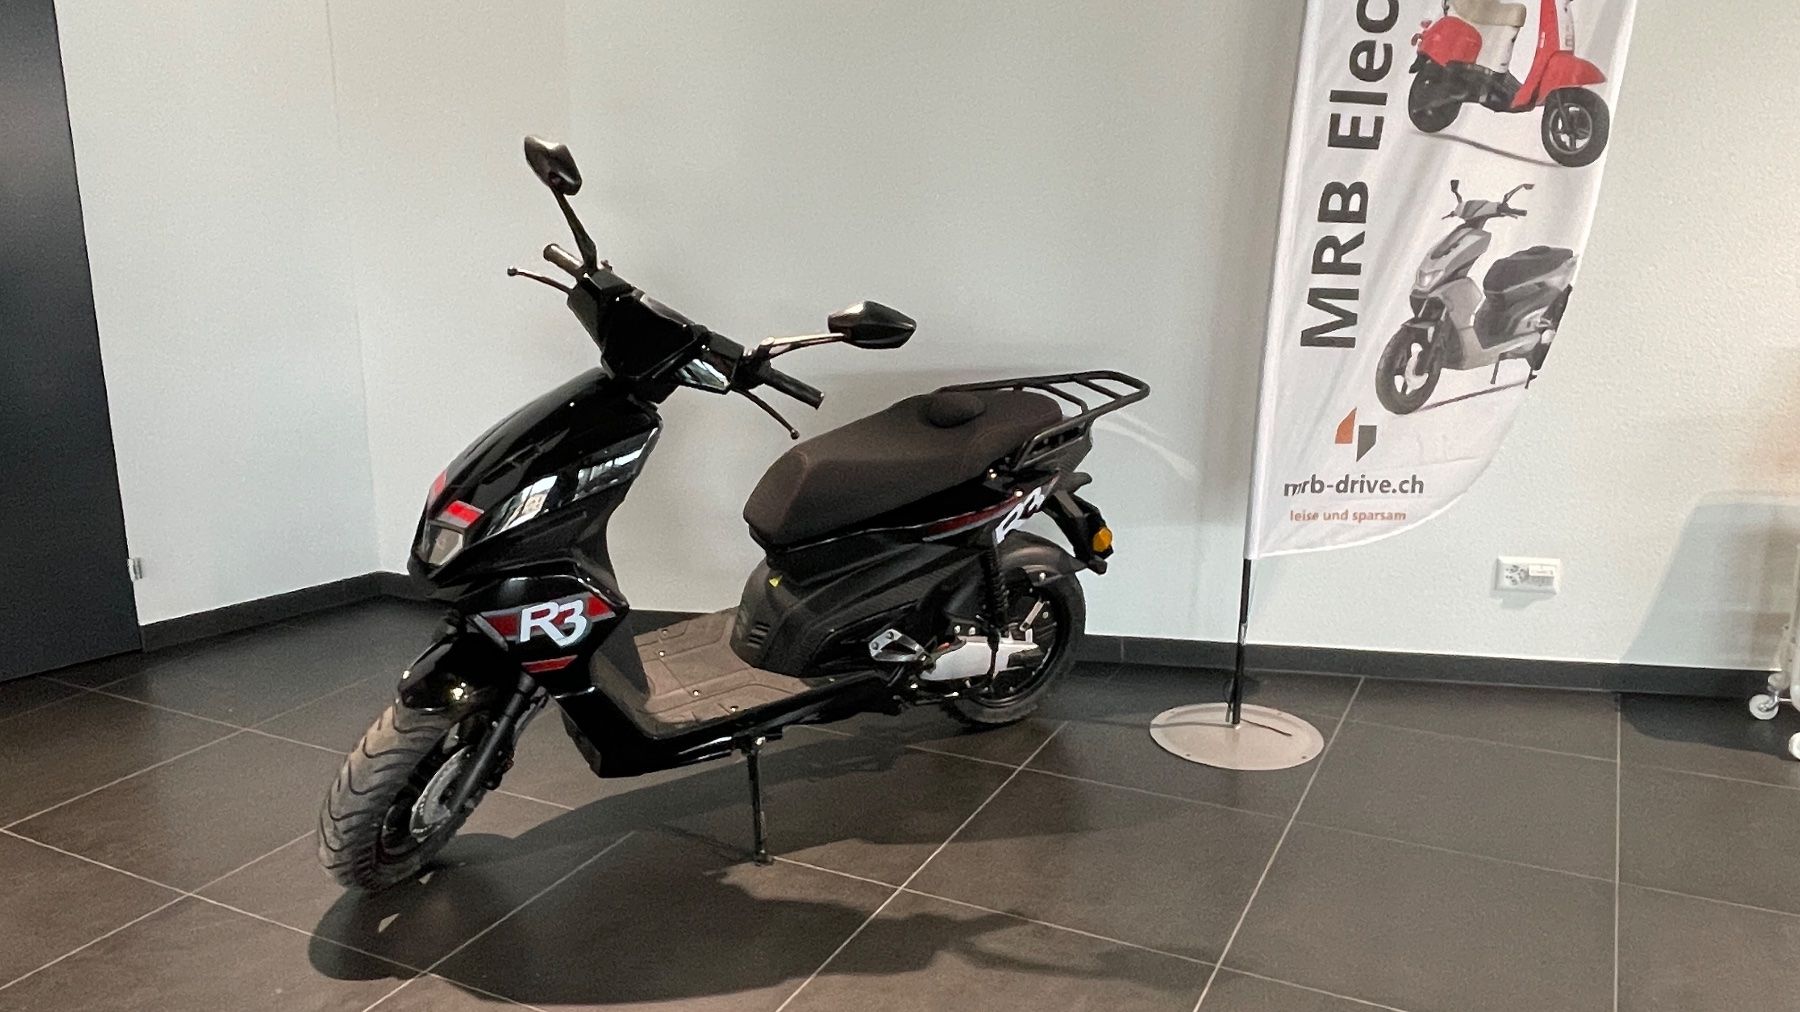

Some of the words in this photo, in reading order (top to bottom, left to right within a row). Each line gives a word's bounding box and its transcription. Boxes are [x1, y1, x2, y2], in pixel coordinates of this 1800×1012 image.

[1328, 0, 1400, 150] Elec
[1300, 181, 1369, 348] MRB
[1284, 474, 1424, 496] mrb-drive.ch
[1290, 510, 1319, 522] leise
[1323, 509, 1348, 521] und
[1352, 510, 1407, 524] sparsam
[519, 599, 588, 647] R3
